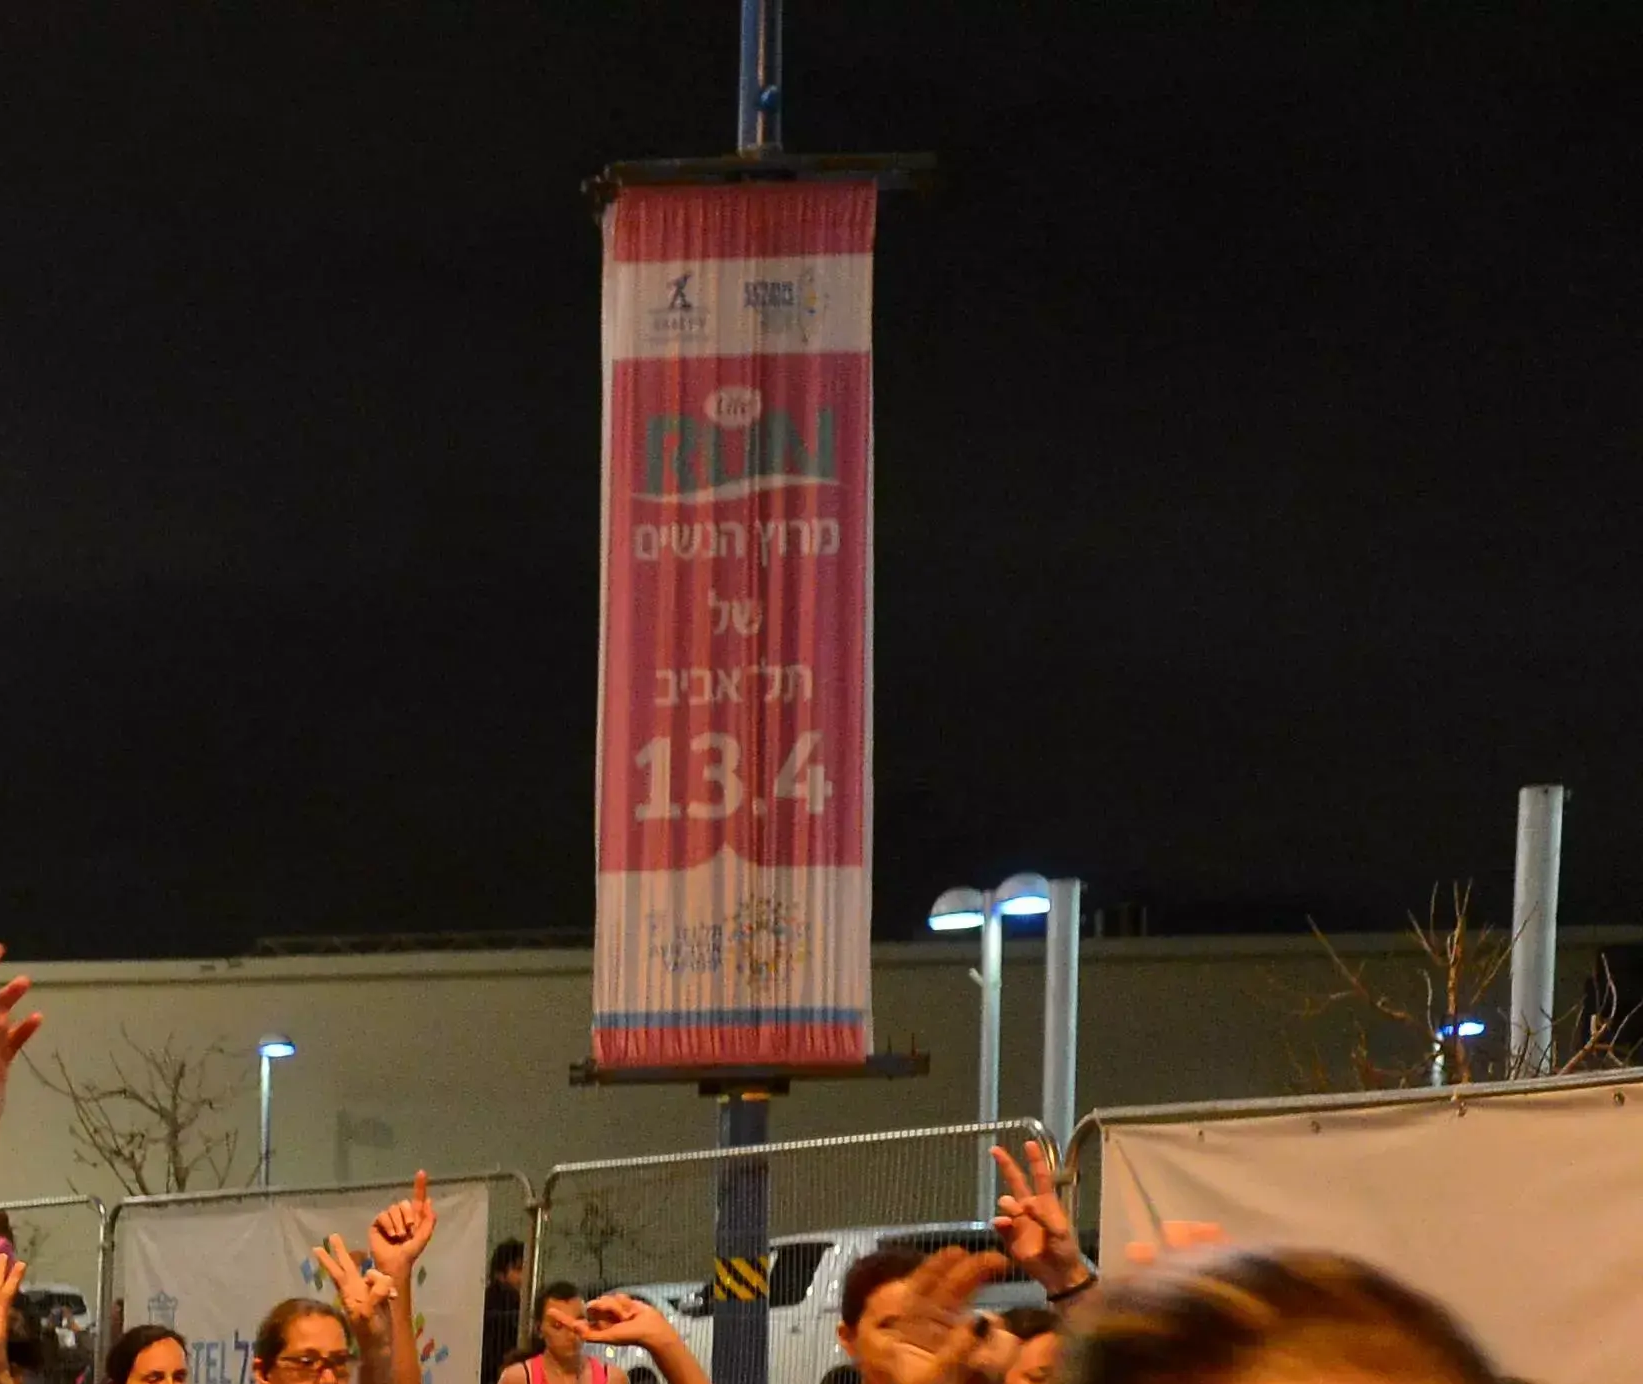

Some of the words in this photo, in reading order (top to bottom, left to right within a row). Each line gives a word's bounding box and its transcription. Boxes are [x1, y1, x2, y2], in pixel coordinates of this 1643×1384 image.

[645, 406, 836, 496] RUN
[634, 520, 746, 562] הנשים
[755, 516, 841, 566] מרוץ
[708, 590, 763, 636] של
[635, 730, 833, 821] 13.4
